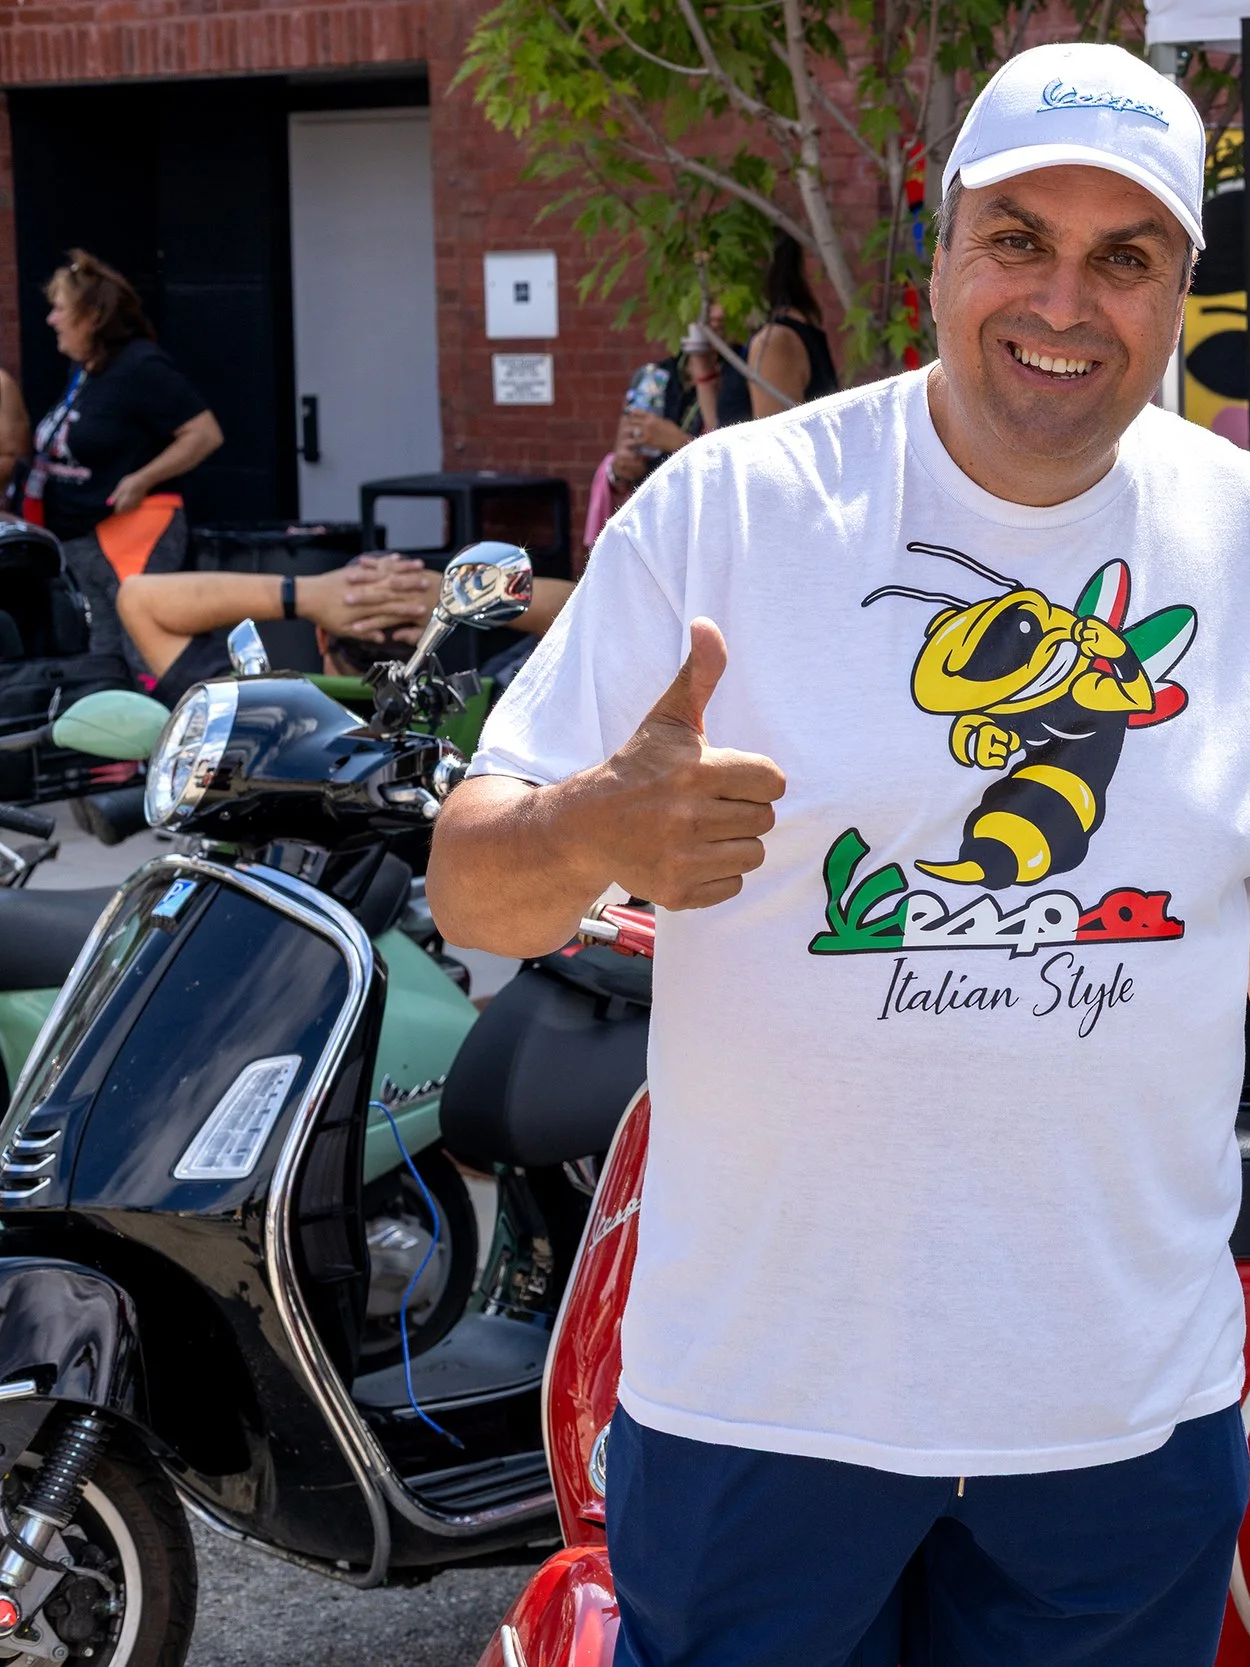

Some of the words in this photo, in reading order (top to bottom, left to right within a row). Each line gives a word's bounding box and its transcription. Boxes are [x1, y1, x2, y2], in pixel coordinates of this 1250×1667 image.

[808, 827, 1185, 959] Vespa
[877, 956, 1019, 1020] Italian
[1032, 951, 1135, 1038] Style
